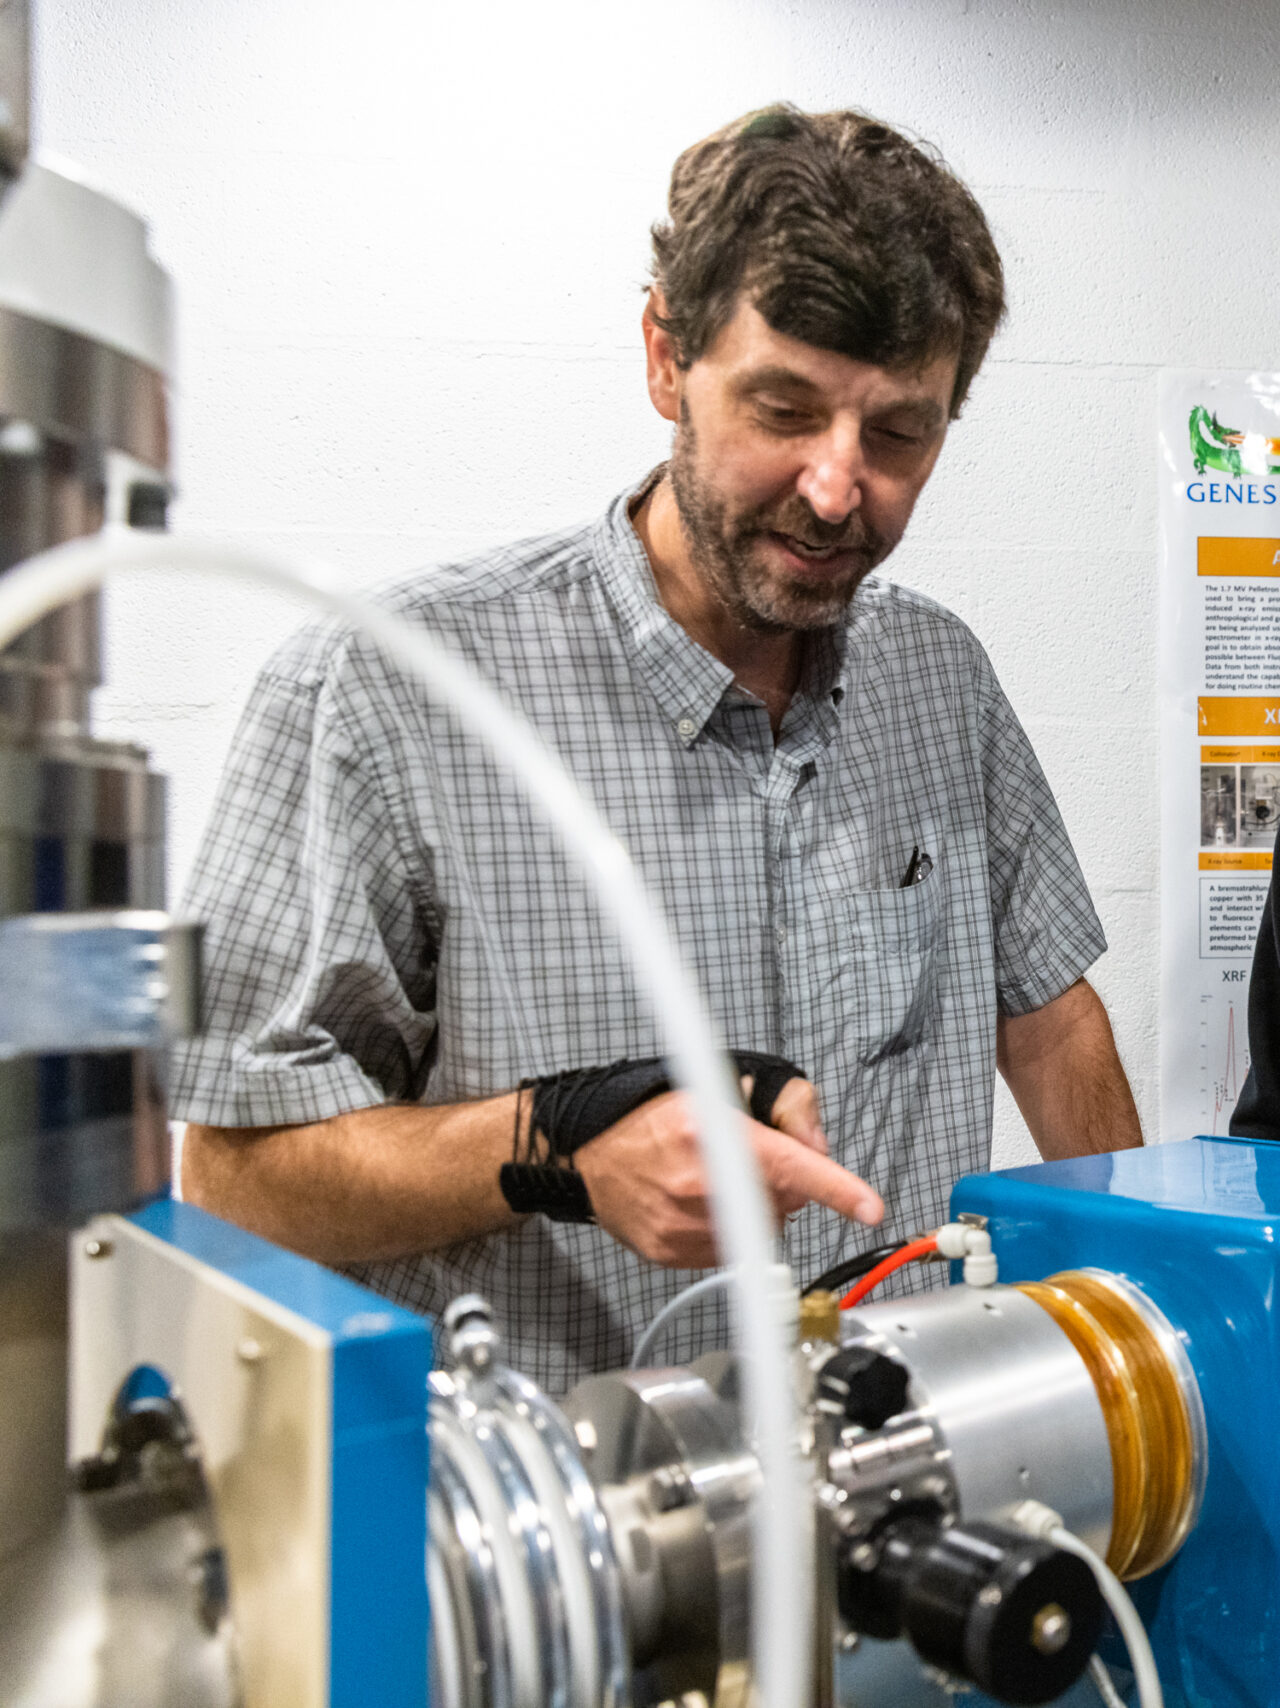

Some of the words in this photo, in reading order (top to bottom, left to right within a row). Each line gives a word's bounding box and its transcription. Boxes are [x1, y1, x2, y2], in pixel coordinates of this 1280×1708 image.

[1205, 584, 1218, 593] The
[1218, 884, 1268, 893] bremsstrahlun
[1209, 896, 1234, 904] copper
[1236, 894, 1252, 902] with
[1210, 904, 1223, 912] and
[1226, 904, 1253, 912] interact
[1209, 914, 1218, 922] to
[1222, 914, 1254, 922] fluoresce
[1209, 924, 1242, 932] elements
[1222, 970, 1247, 982] XRF
